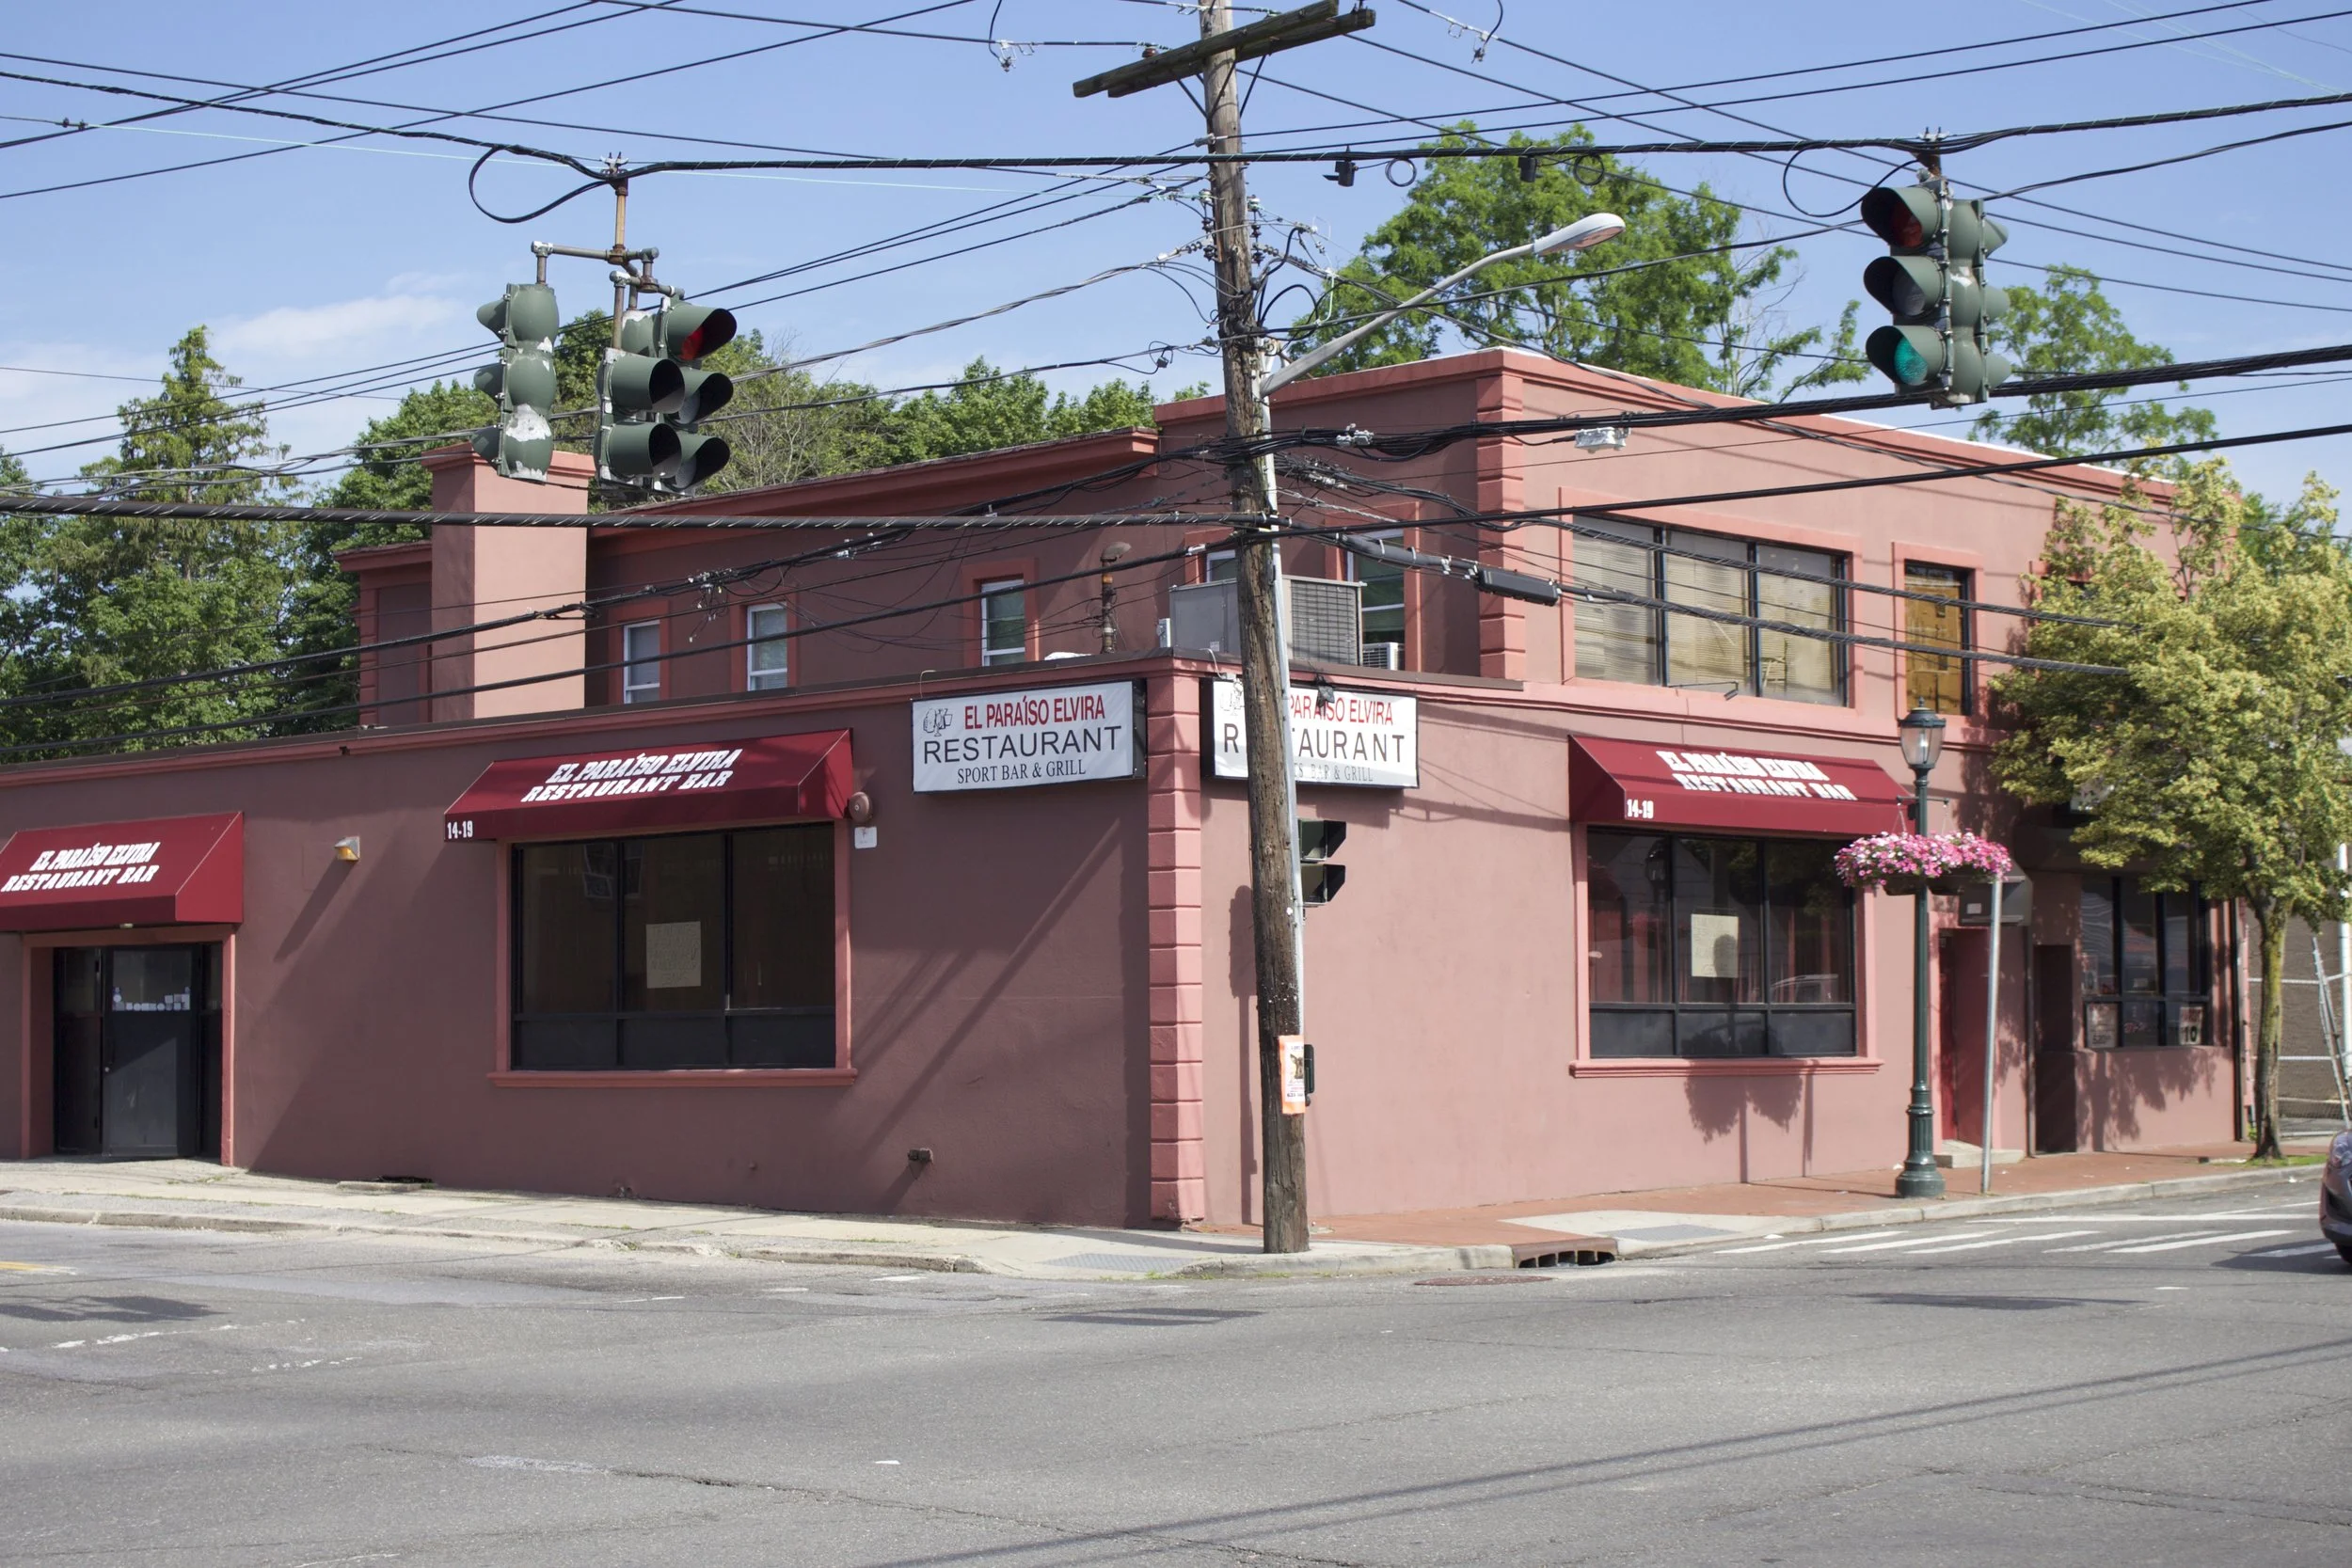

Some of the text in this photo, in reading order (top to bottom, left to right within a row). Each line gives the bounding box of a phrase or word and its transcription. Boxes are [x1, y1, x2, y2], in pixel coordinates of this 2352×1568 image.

[964, 694, 1105, 730] EL PARAÍSO ELVIRA
[1350, 699, 1393, 726] ELVIRA
[924, 725, 1122, 764] RESTAURANT
[1224, 722, 1406, 763] RAURANT
[546, 749, 743, 784] EL PARAÍSO ELVIRA
[957, 759, 1087, 784] SPORT BAR & GRILL
[1334, 765, 1341, 780] &
[1344, 765, 1374, 783] GRILL
[520, 770, 734, 803] RESTAURANT BAR
[1672, 772, 1859, 801] RESTAURANT BAR
[29, 842, 161, 872] EL PARAÍSO ELVIRA
[0, 864, 160, 893] RESTAURANT BAR
